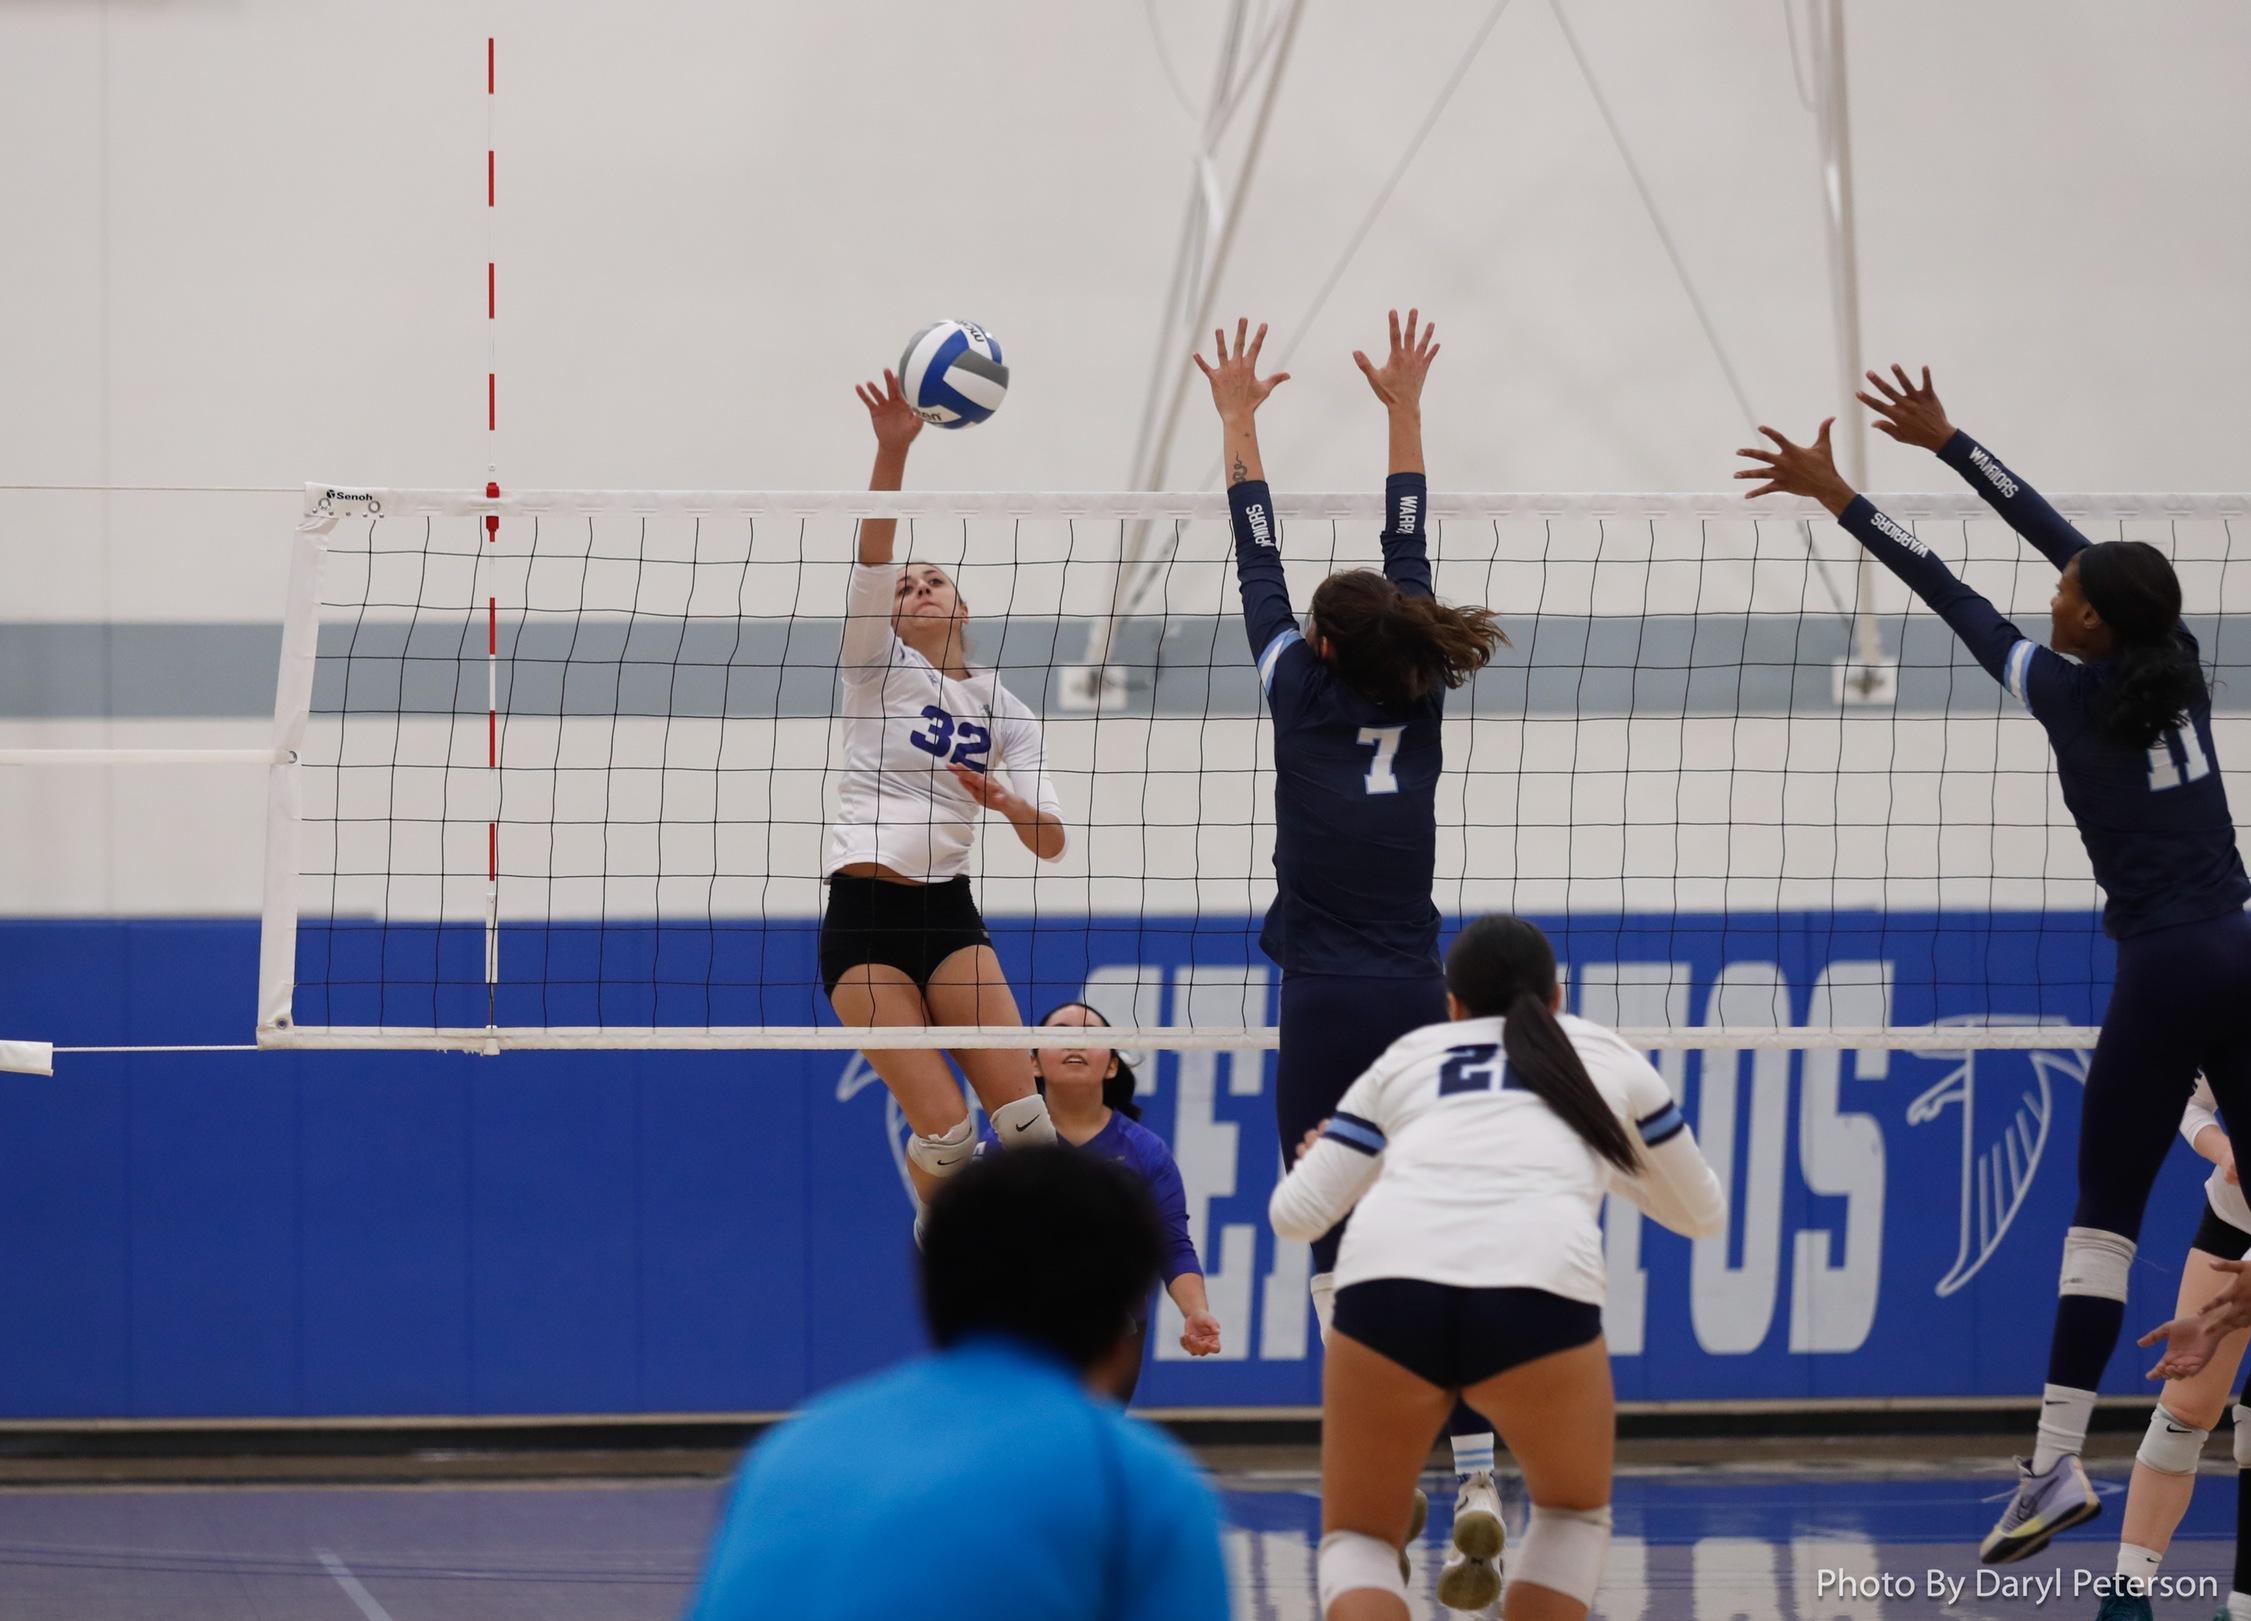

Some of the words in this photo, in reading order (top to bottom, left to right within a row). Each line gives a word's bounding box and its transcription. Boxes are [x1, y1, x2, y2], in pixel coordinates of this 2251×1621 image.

[336, 491, 373, 501] Senoh
[1870, 511, 1929, 559] WARRIORS
[910, 705, 991, 774] 32
[1356, 725, 1408, 794] 7
[2146, 709, 2210, 792] 11
